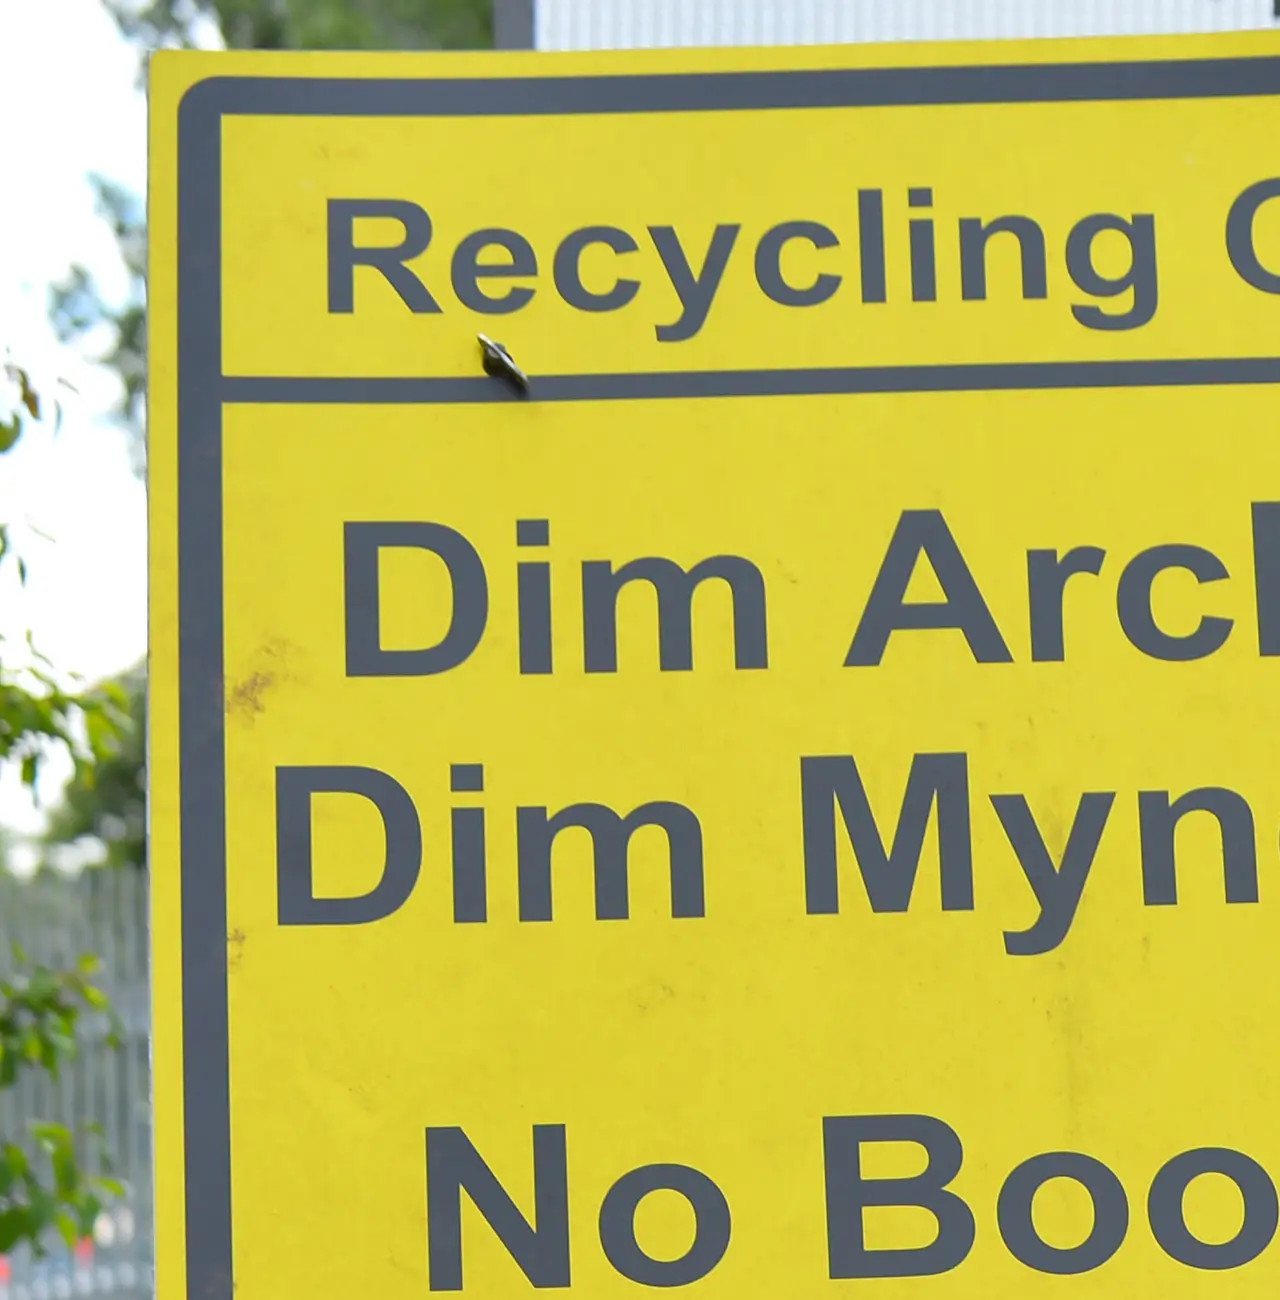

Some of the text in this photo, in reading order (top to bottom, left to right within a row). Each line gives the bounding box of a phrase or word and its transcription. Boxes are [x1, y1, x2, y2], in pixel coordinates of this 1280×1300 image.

[327, 188, 1158, 342] Recycling
[344, 519, 768, 677] Dim
[276, 764, 705, 925] Dim
[426, 1124, 731, 1291] No
